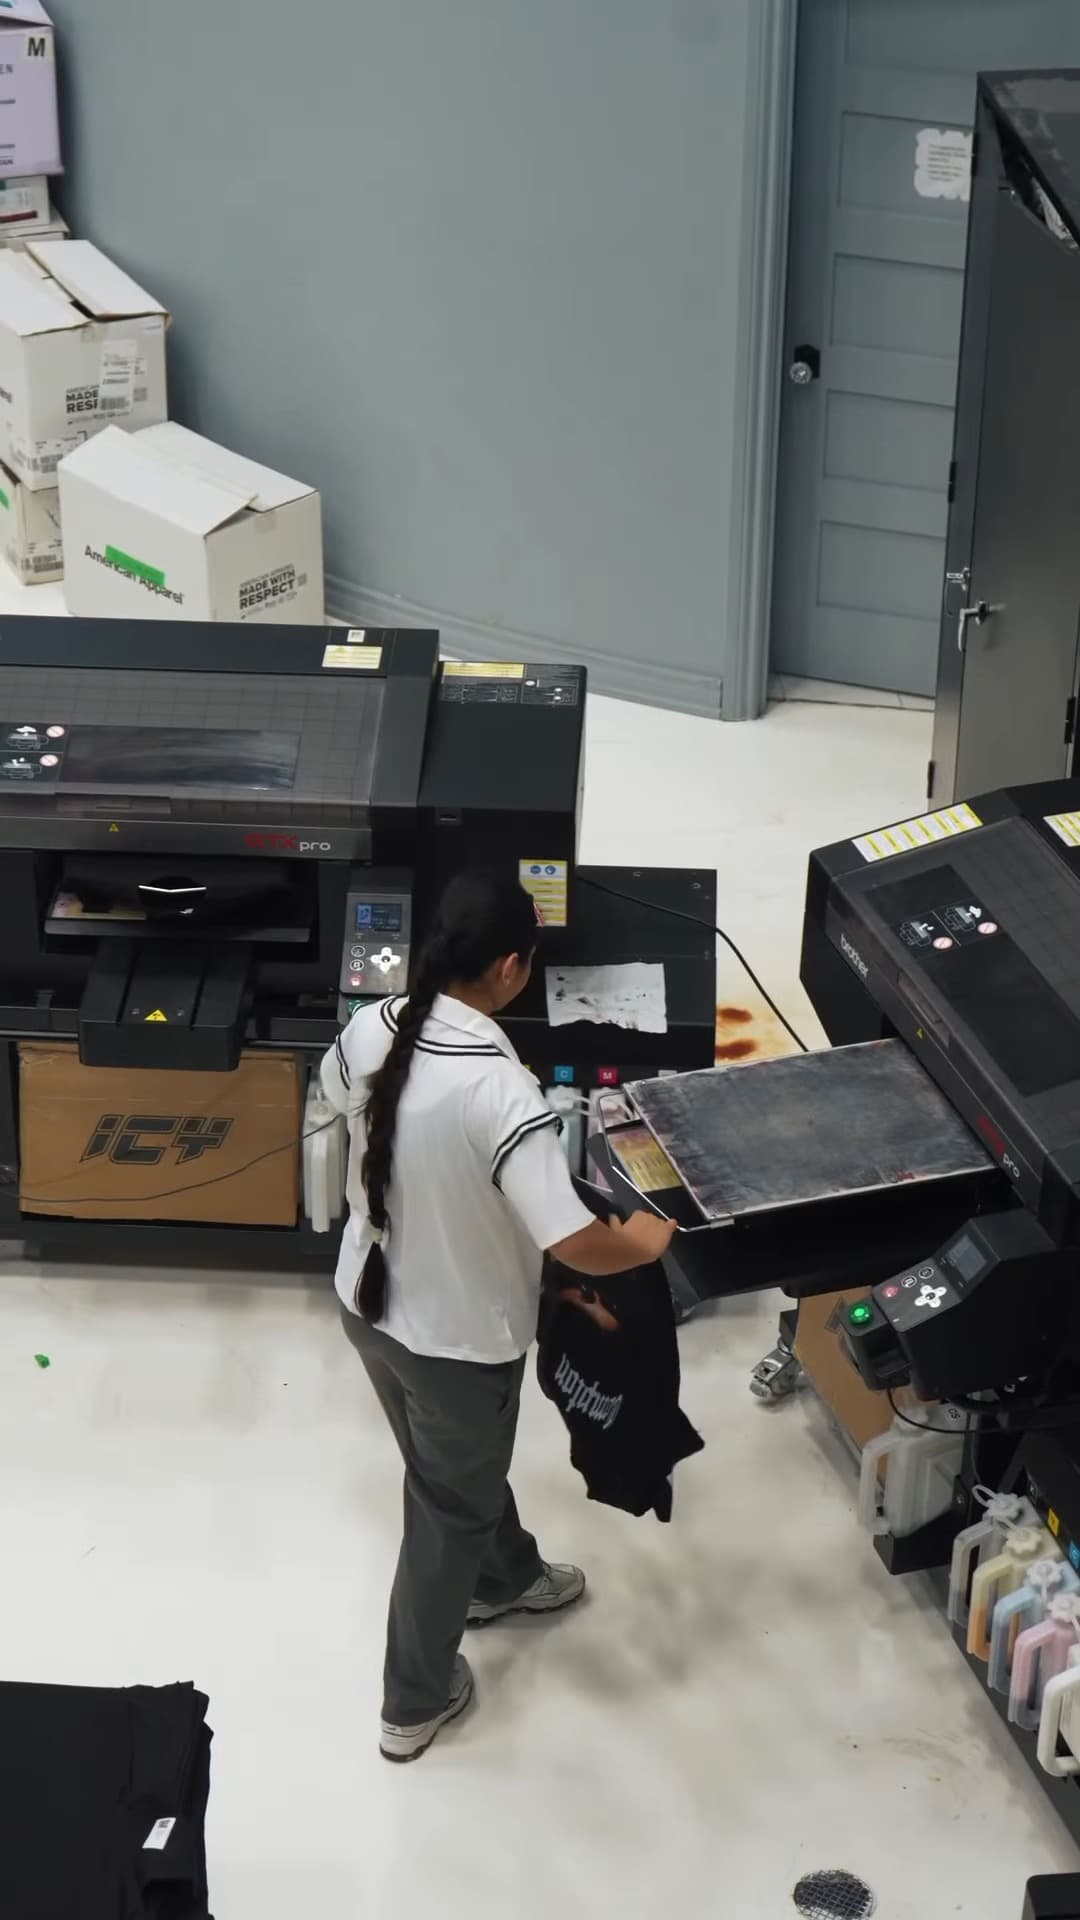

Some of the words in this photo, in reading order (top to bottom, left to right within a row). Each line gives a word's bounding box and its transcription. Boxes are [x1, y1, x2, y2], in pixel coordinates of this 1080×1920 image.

[27, 37, 46, 57] M
[66, 389, 98, 401] MADE
[240, 579, 268, 597] MADE
[270, 568, 295, 585] WITH
[240, 578, 295, 610] RESPECT
[299, 841, 331, 851] pro
[560, 1069, 568, 1078] C
[603, 1072, 612, 1080] M
